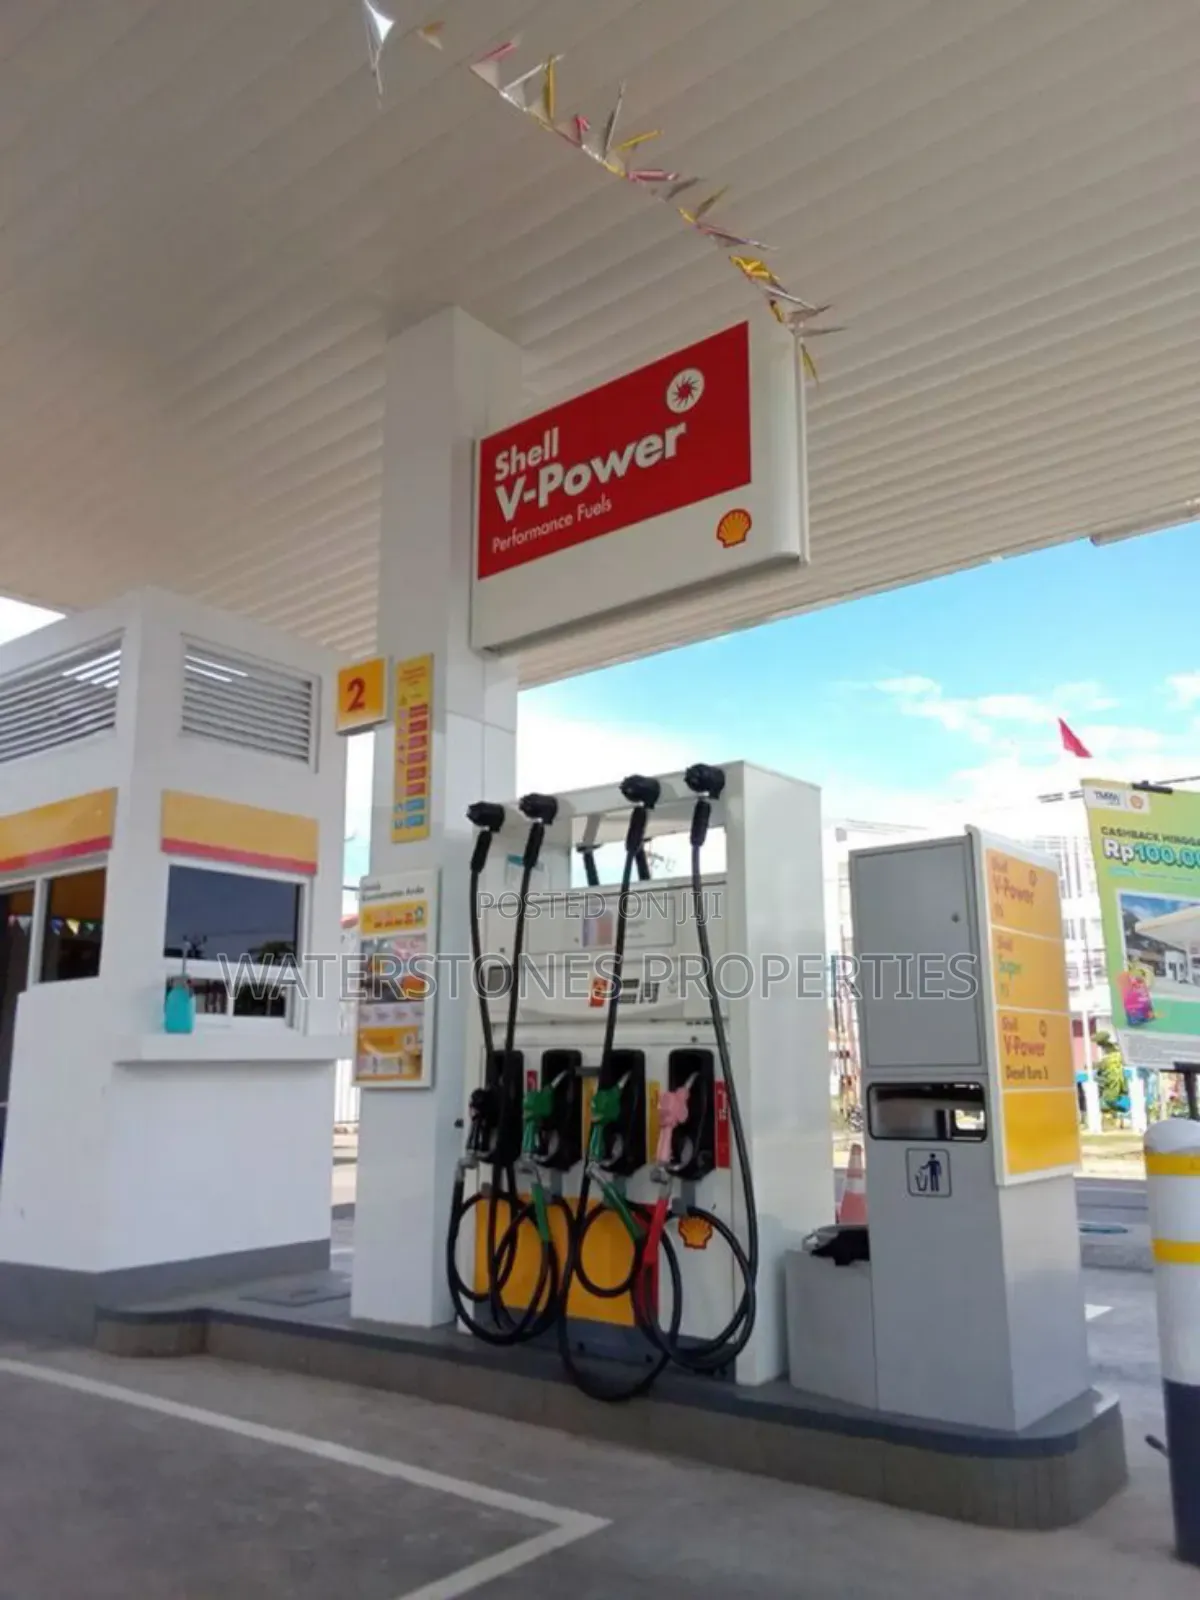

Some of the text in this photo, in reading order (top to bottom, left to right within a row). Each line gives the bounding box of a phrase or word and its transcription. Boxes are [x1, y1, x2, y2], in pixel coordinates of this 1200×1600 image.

[494, 426, 560, 482] Shell
[495, 422, 687, 523] V-Power
[491, 493, 613, 553] Performance Fuels
[347, 678, 366, 711] 2
[1100, 825, 1159, 841] CASHBACK
[992, 872, 1035, 907] V-Power
[1003, 1034, 1046, 1058] V-Power
